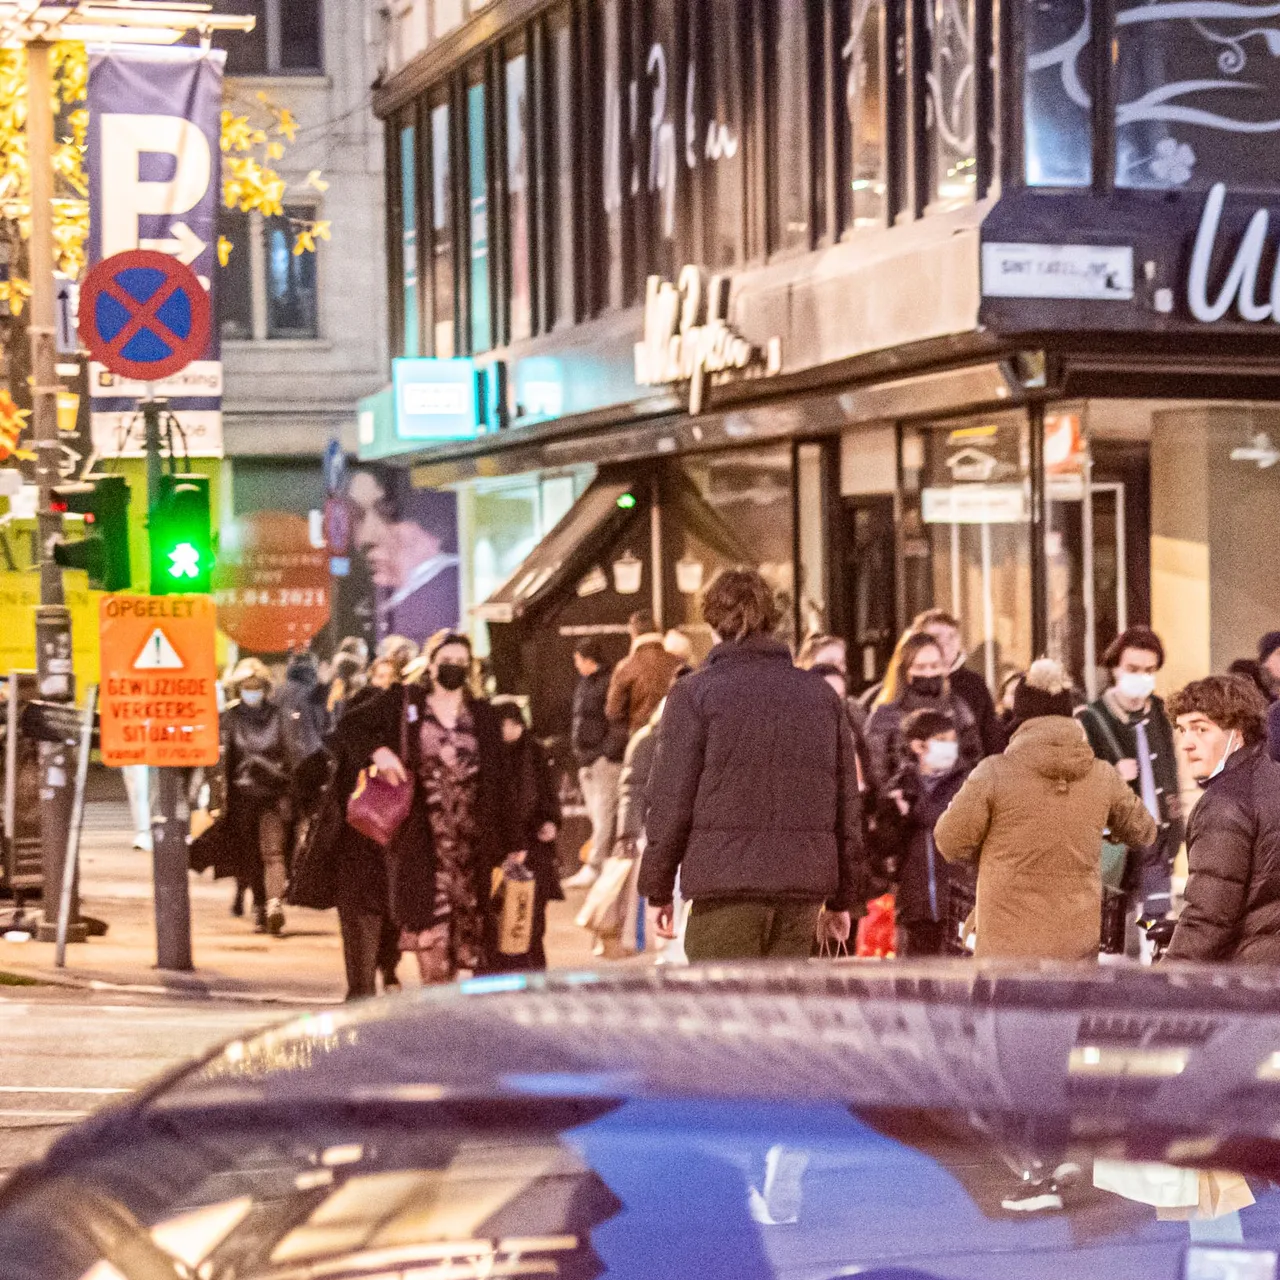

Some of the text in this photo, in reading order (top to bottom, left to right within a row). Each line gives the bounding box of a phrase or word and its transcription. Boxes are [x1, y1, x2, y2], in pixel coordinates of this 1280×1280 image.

[99, 113, 210, 253] P
[106, 601, 195, 618] OPGELET
[107, 678, 208, 697] GEWIJZIGDE
[110, 701, 207, 719] VERKEERS-
[122, 725, 195, 743] SITUATIE
